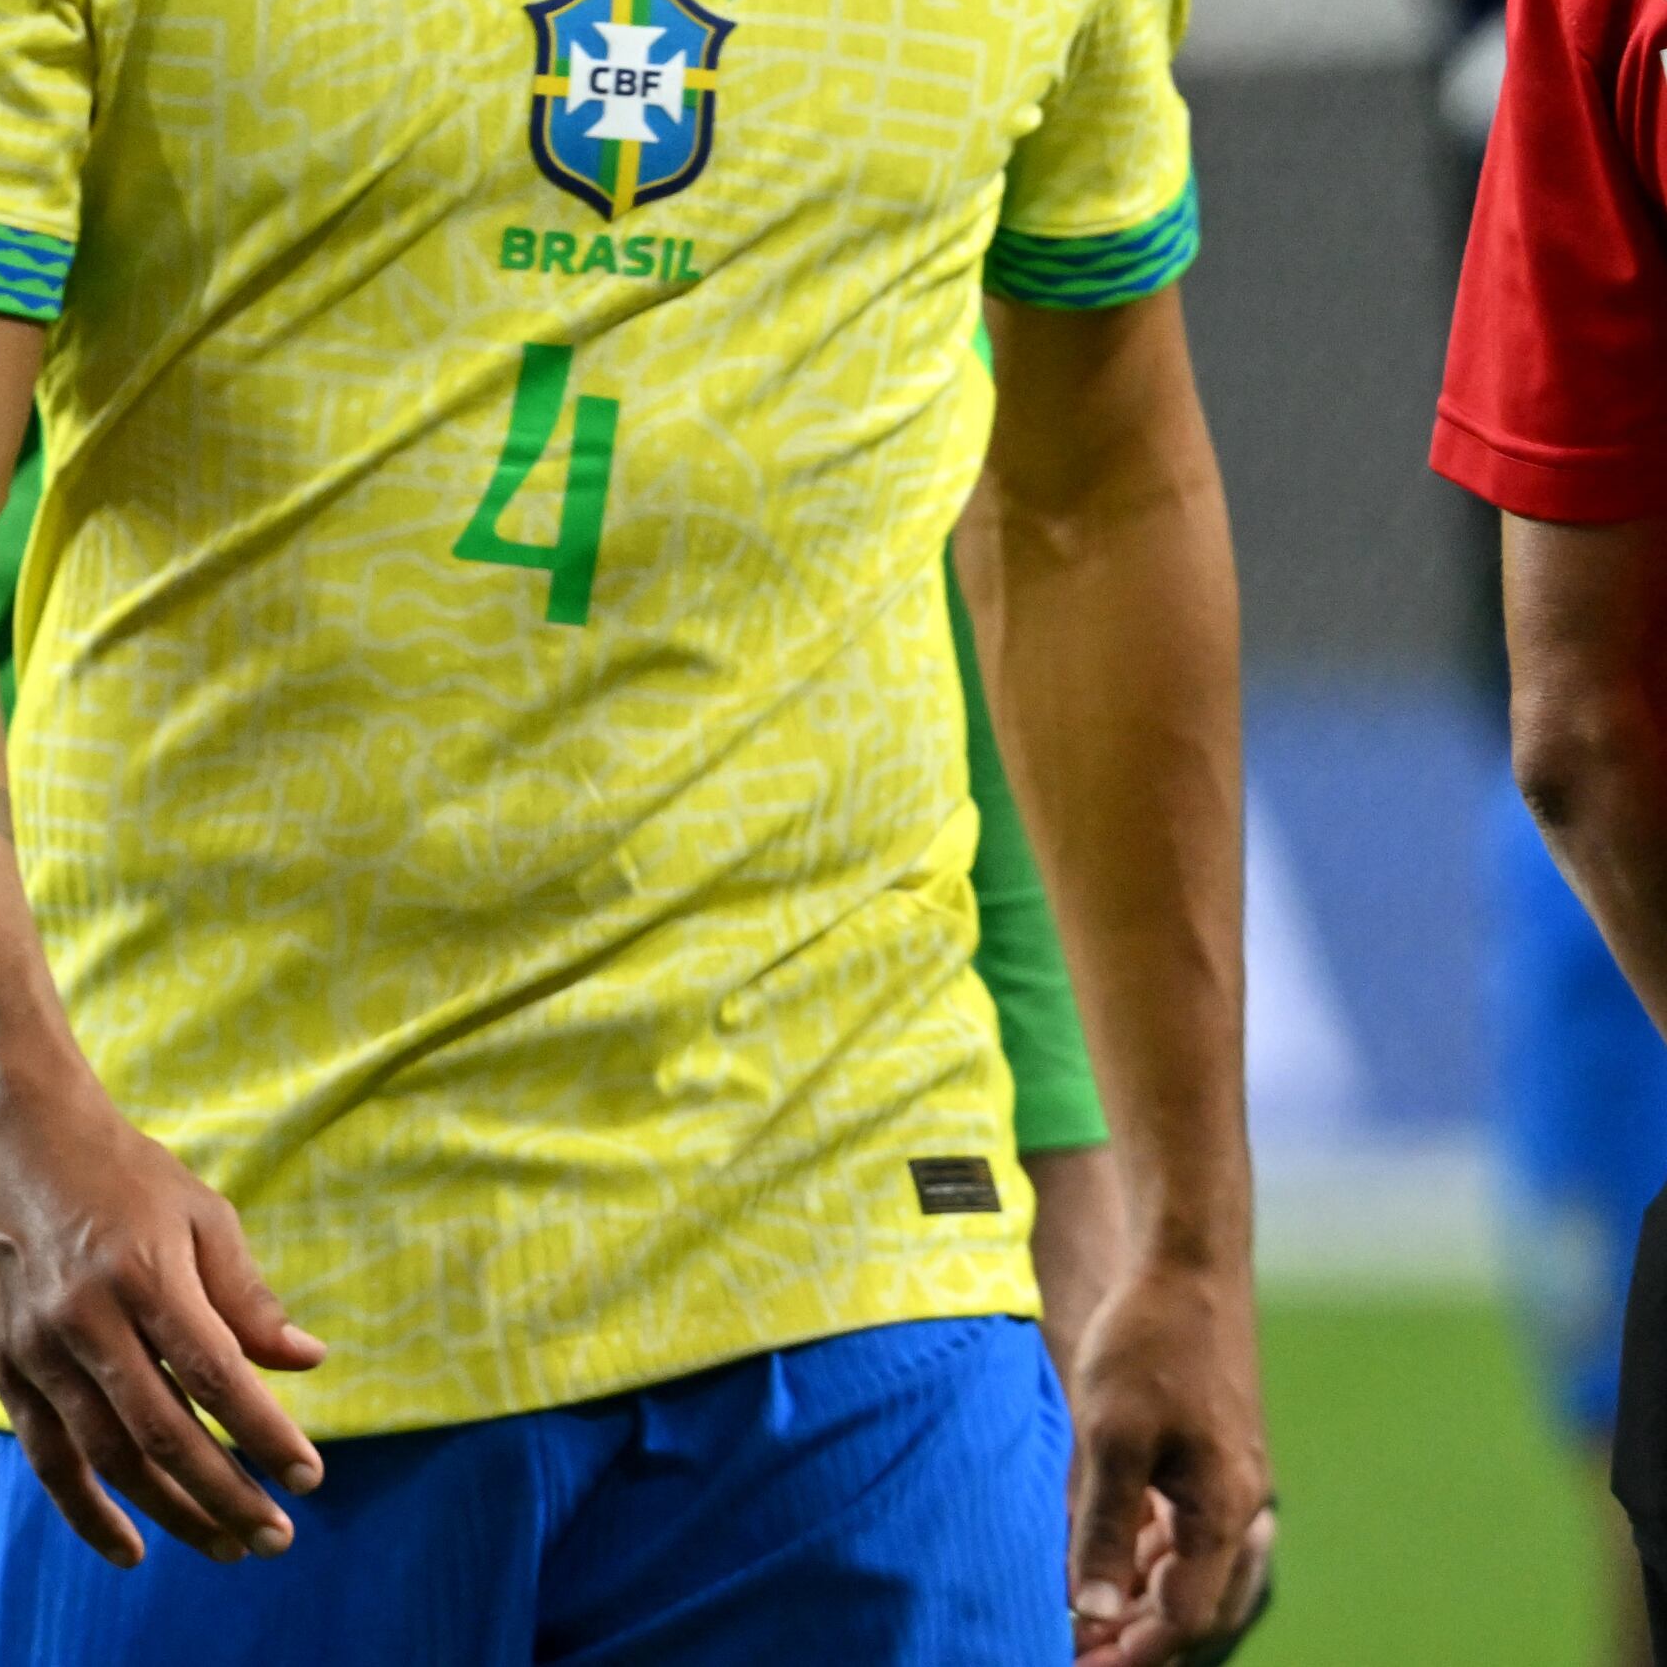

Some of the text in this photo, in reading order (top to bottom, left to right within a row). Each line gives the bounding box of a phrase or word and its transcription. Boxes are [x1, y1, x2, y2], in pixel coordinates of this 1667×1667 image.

[590, 66, 662, 97] CBF
[501, 227, 701, 282] BRASIL
[453, 342, 619, 626] 4
